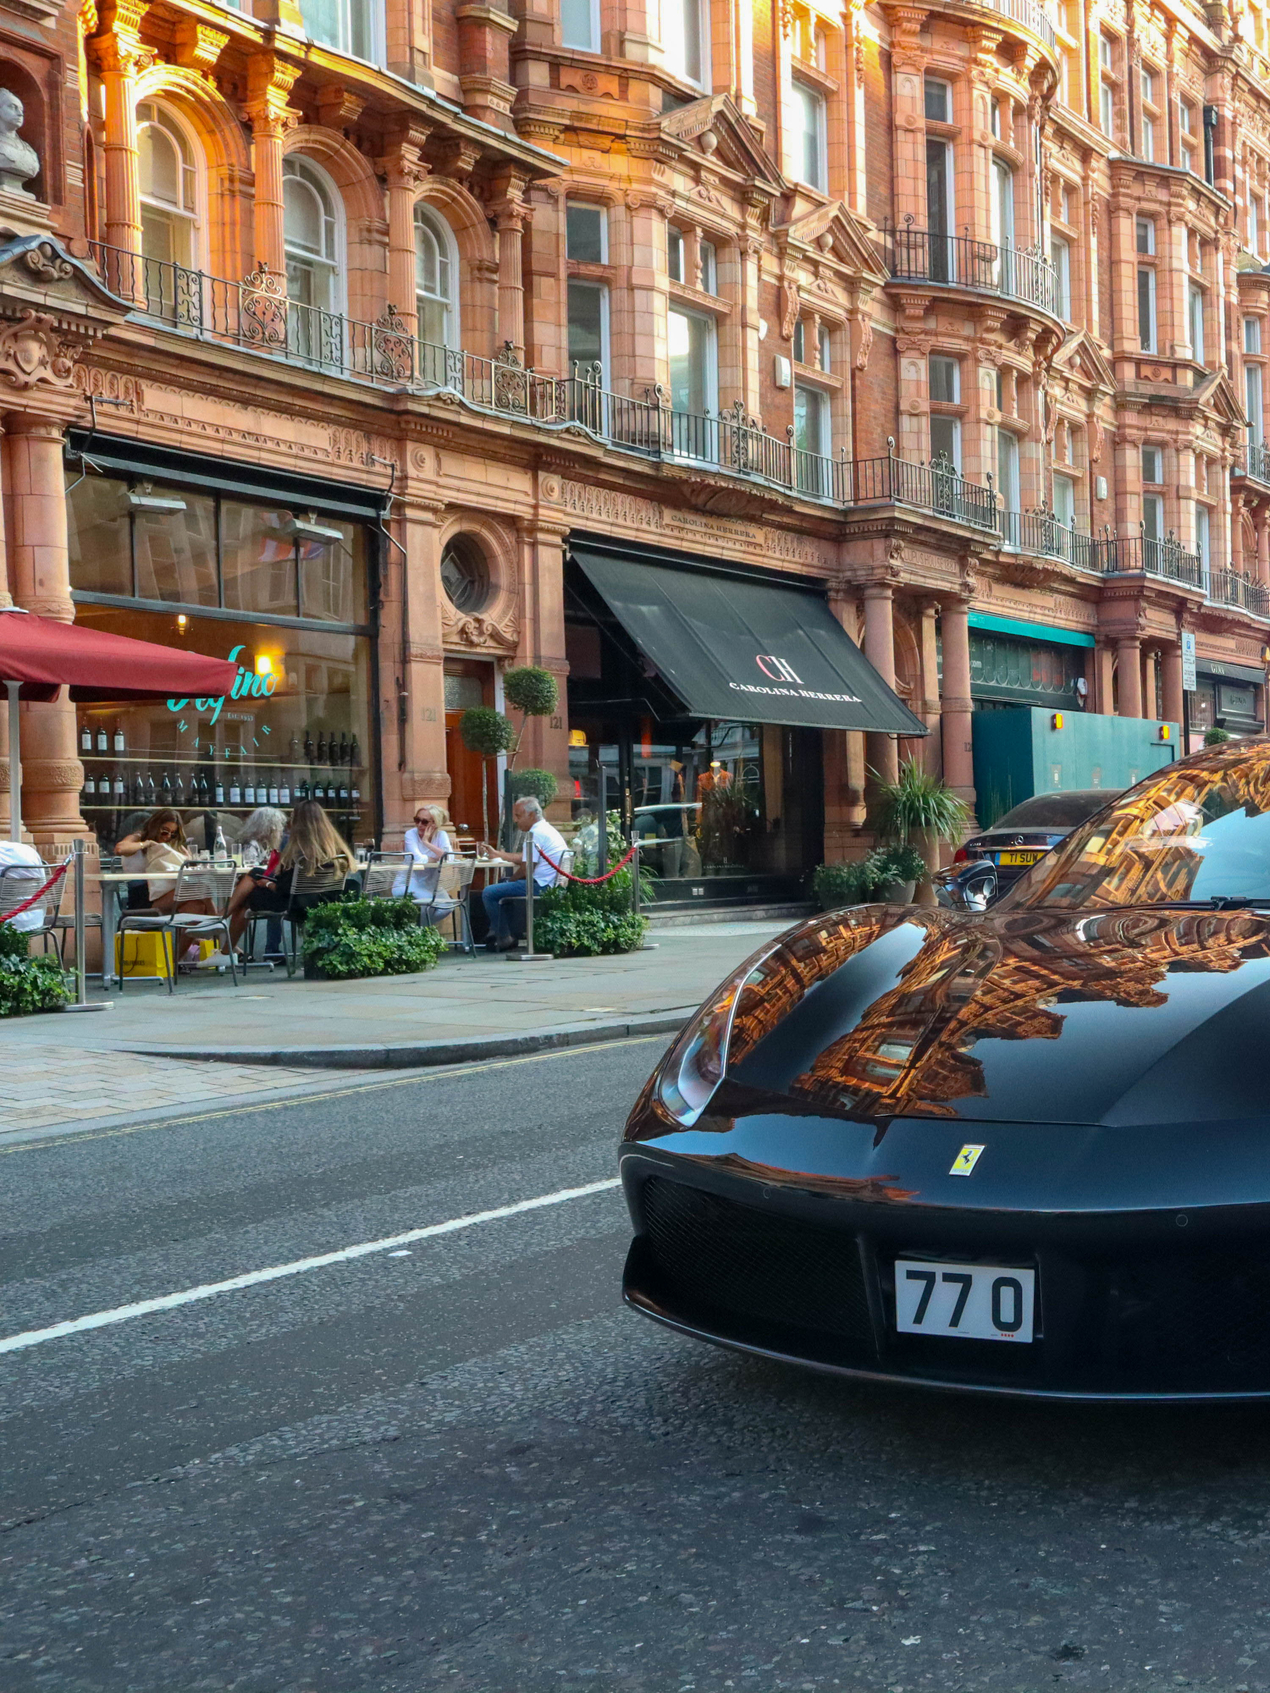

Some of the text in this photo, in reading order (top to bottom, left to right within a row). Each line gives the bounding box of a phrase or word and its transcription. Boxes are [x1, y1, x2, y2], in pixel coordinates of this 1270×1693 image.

[671, 514, 757, 540] CAROLINA HERRERA
[729, 682, 862, 702] CAROLINA HERRERA
[549, 716, 562, 730] 121
[177, 719, 271, 758] MAYFAIR
